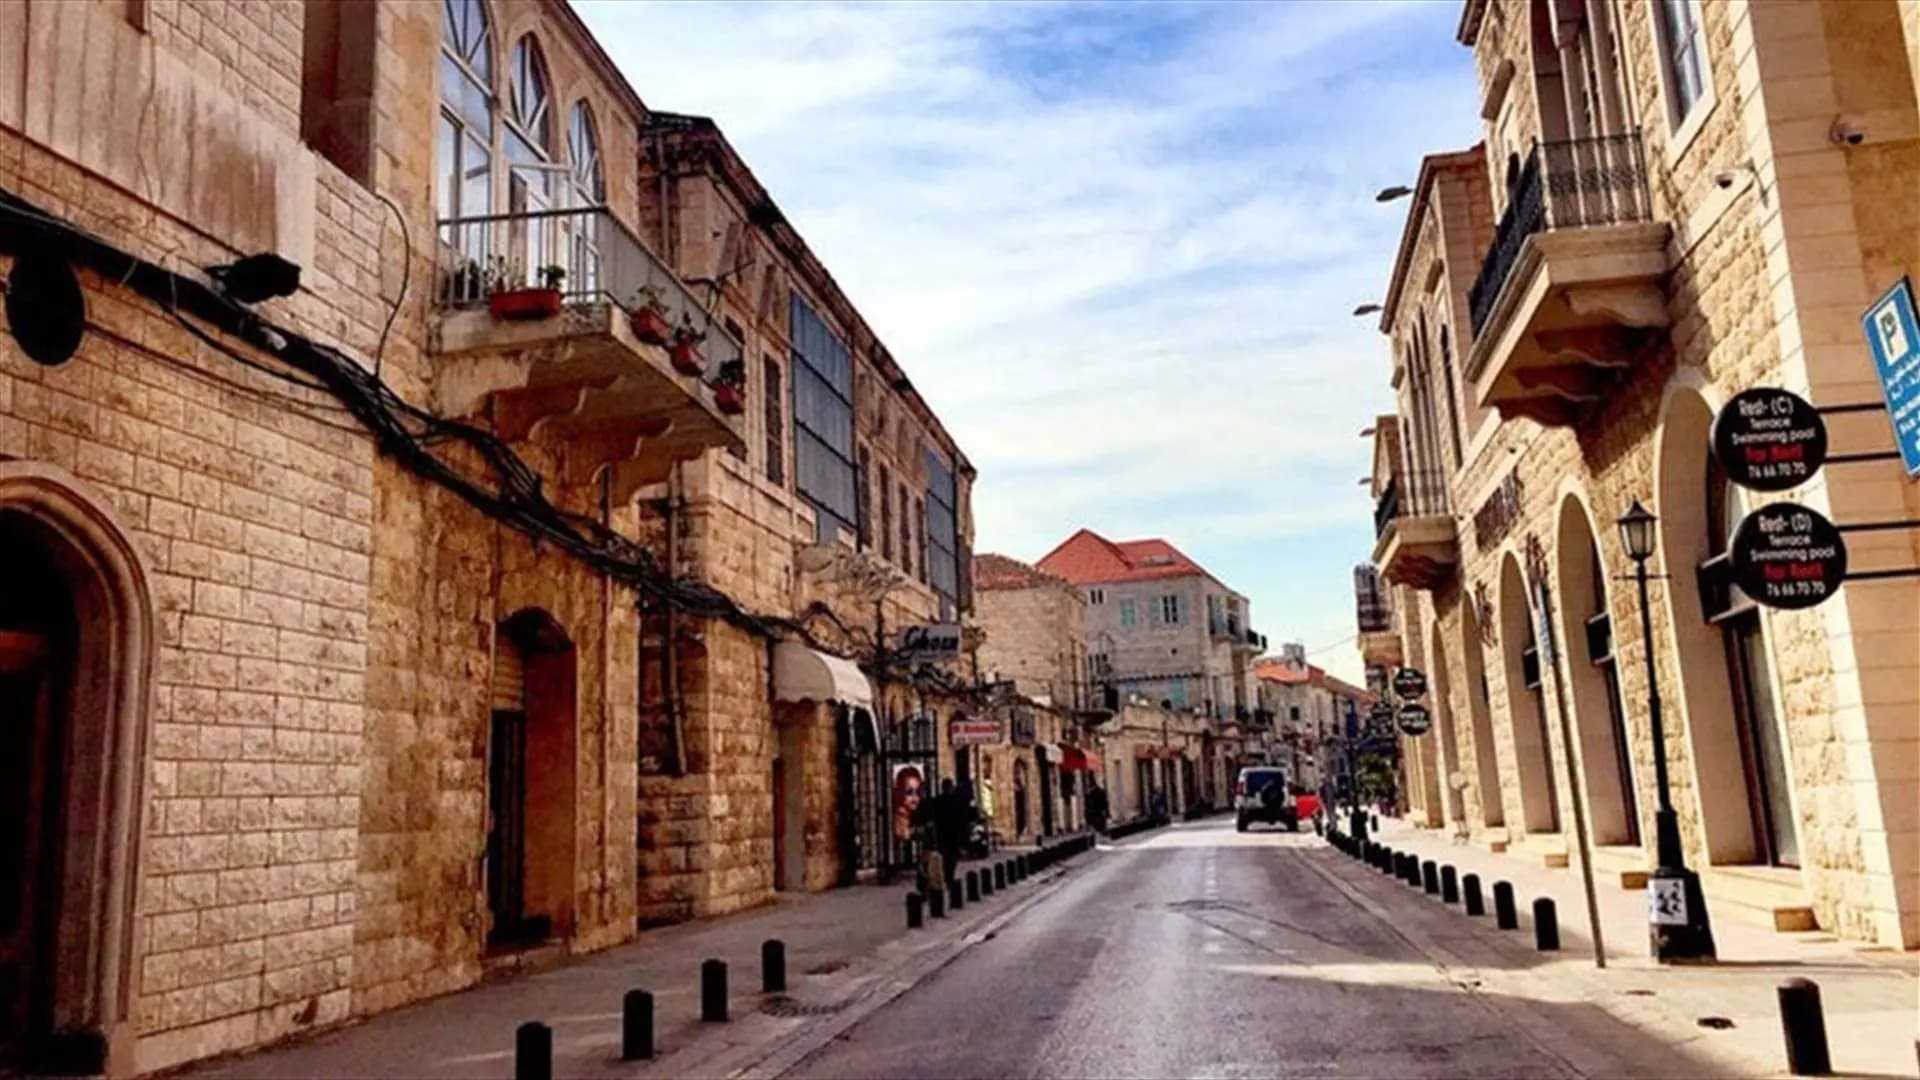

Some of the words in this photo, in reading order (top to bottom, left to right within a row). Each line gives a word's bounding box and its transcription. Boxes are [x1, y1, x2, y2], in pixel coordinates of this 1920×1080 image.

[1881, 311, 1897, 355] P
[1771, 396, 1794, 415] (C)
[1750, 418, 1791, 429] Terrace
[1731, 431, 1788, 446] Swimming
[1789, 427, 1816, 442] pool
[1768, 535, 1811, 546] Terrace
[1750, 549, 1807, 562] Swimming
[1808, 546, 1835, 559] pool
